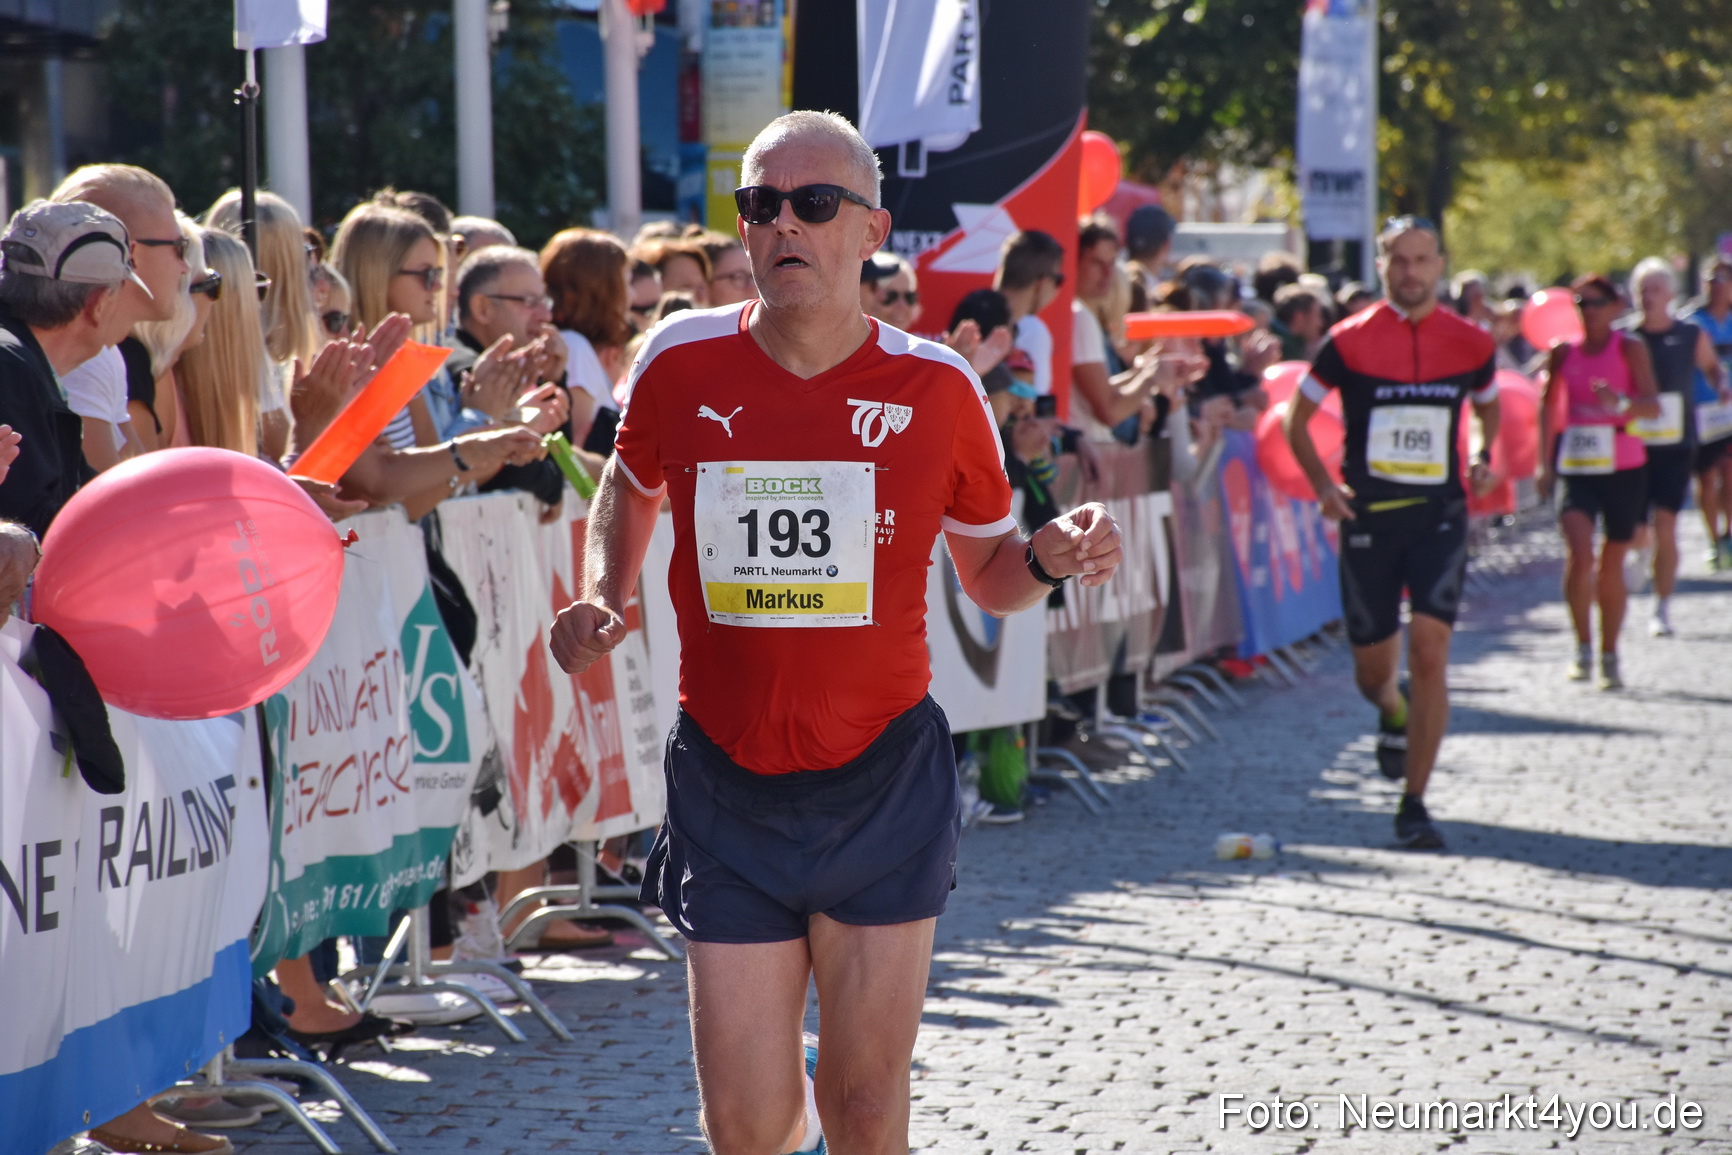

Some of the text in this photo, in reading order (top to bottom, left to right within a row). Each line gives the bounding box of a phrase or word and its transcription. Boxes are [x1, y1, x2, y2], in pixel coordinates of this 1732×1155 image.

[948, 0, 974, 105] PART
[1390, 429, 1431, 452] 169
[745, 477, 823, 494] BOCK
[738, 509, 831, 558] 193
[707, 547, 713, 557] B
[733, 566, 823, 577] PARTL Neumarkt
[229, 520, 281, 667] RÖDL
[746, 588, 824, 610] Markus
[415, 775, 439, 791] rvice
[339, 883, 364, 910] 81
